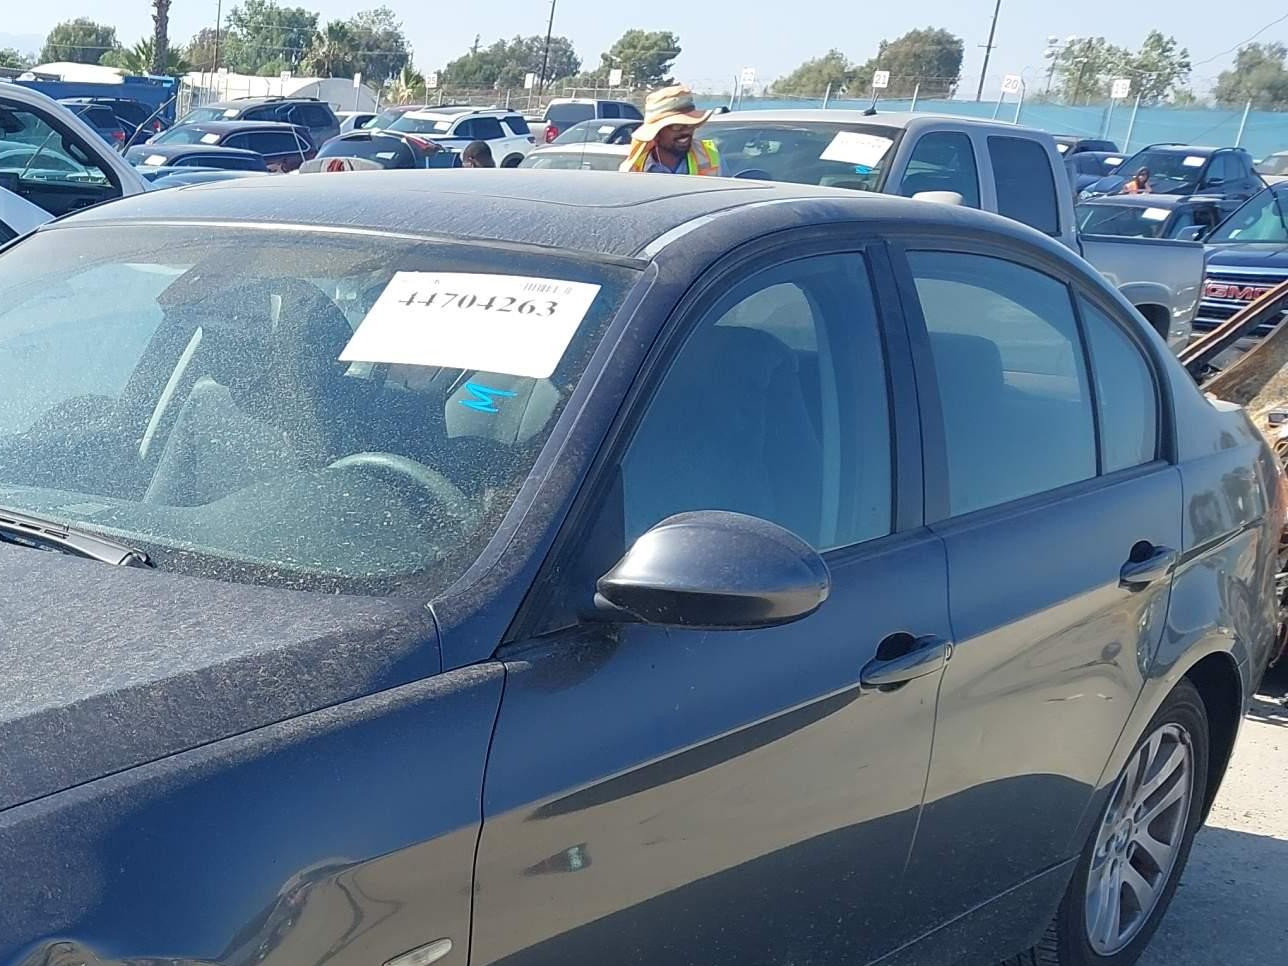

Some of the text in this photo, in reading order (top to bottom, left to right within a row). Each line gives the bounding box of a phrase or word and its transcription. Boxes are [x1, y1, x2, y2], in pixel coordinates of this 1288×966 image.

[874, 74, 886, 85] 21
[1004, 78, 1019, 90] 20
[398, 291, 559, 317] 44704263
